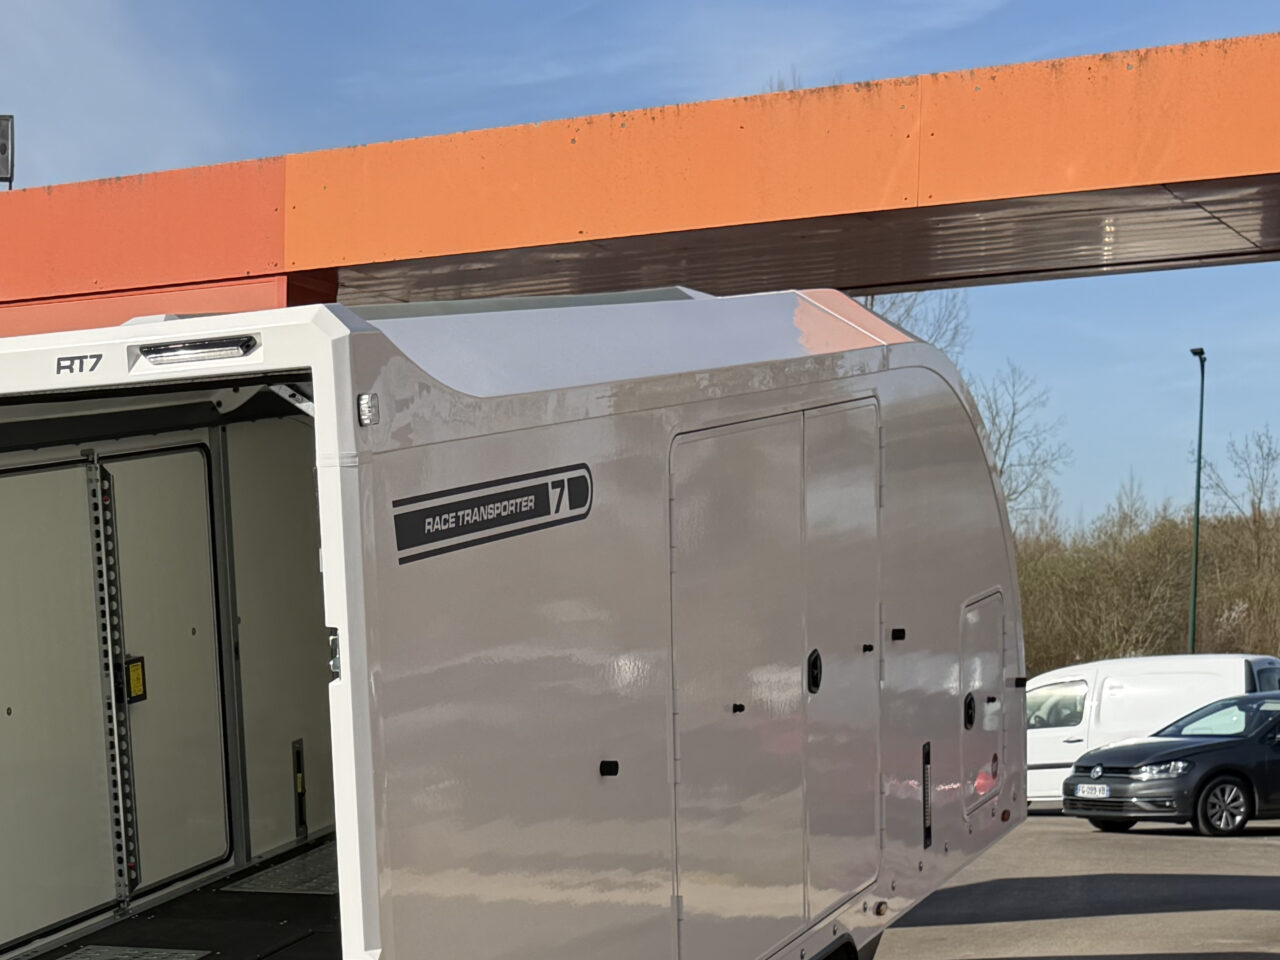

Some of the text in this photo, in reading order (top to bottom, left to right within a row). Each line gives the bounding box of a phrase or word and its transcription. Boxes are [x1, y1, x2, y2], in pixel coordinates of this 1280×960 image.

[56, 353, 103, 375] RT7
[424, 478, 566, 535] RACE TRANSPORTER 7
